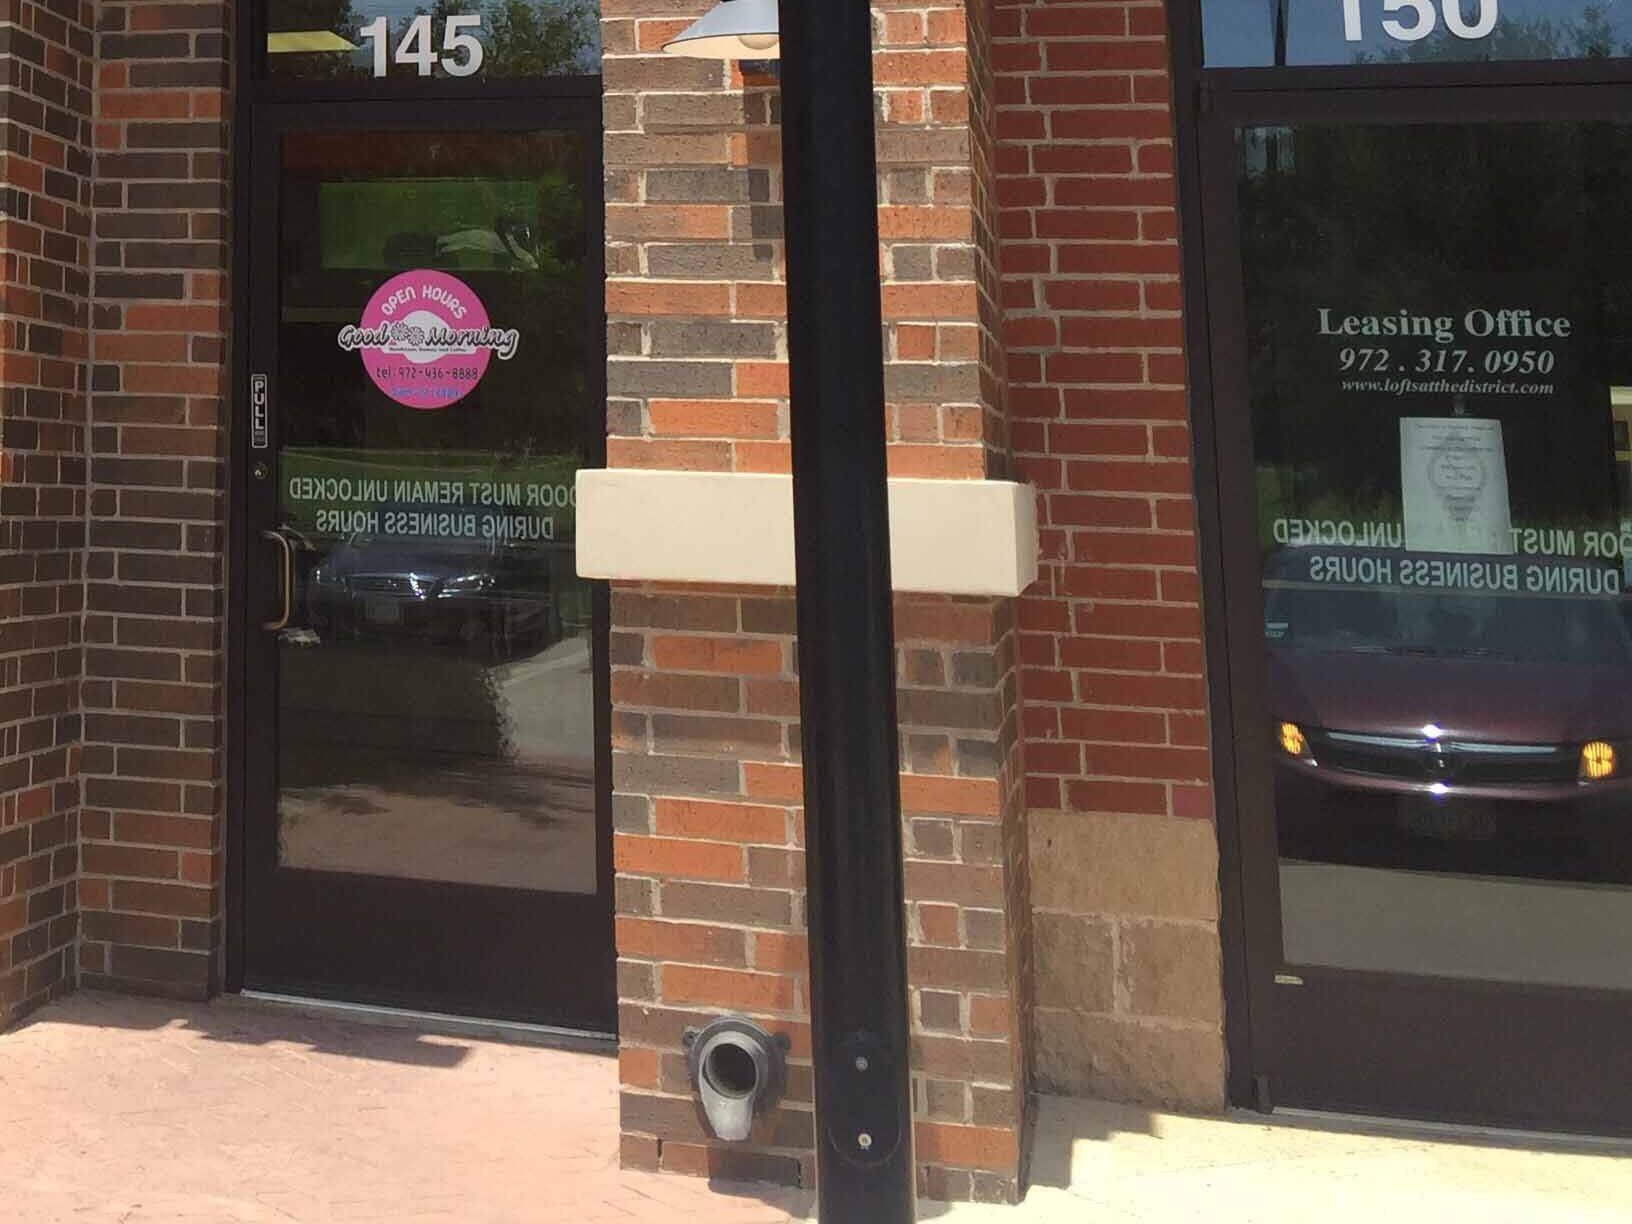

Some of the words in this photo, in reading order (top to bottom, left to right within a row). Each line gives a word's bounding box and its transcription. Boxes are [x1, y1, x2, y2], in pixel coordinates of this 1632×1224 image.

[359, 14, 484, 77] 145
[381, 286, 417, 316] OPEN
[422, 285, 467, 319] HOURS
[338, 321, 390, 351] Good
[423, 324, 520, 360] Morning
[1317, 307, 1455, 344] Leasing
[1464, 307, 1572, 338] Office
[253, 380, 265, 430] PULL
[1341, 378, 1555, 396] www.loftsatthedistrict.com
